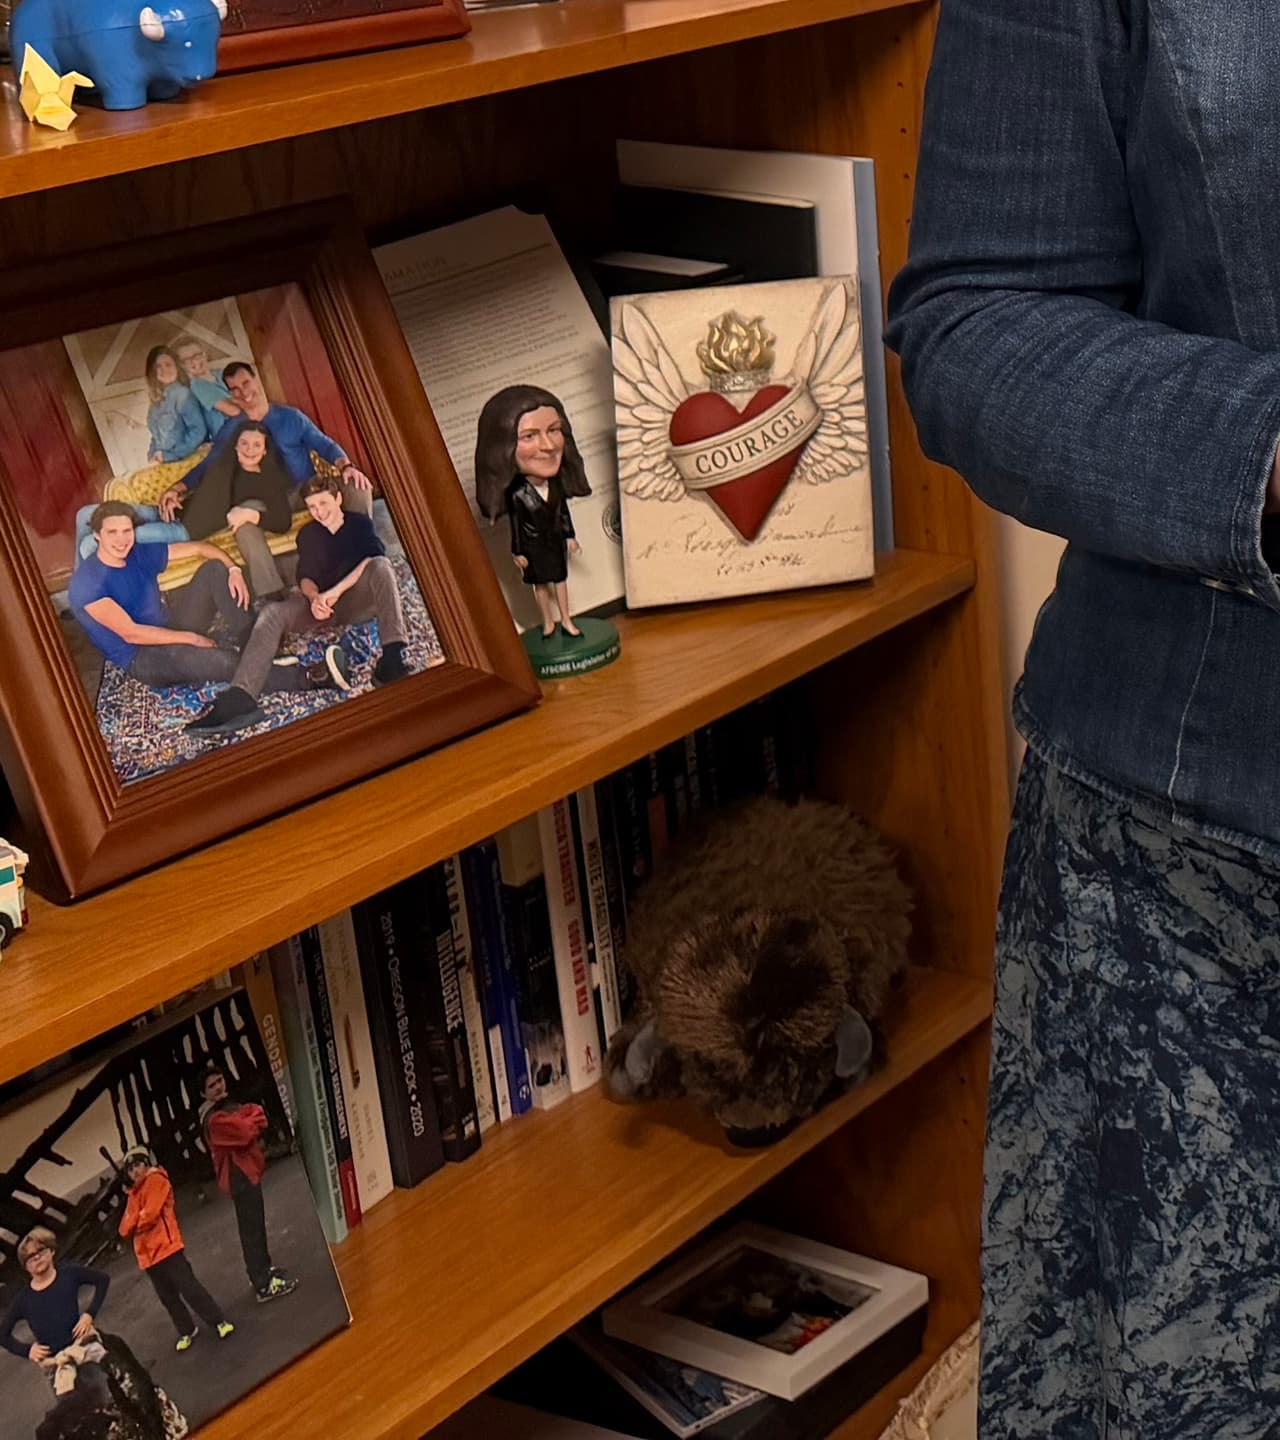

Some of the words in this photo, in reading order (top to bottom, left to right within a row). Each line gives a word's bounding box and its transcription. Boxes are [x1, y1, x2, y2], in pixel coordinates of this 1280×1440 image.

[696, 416, 805, 474] COURAGE
[381, 912, 395, 945] 2019
[388, 957, 406, 1016] OREGON
[436, 929, 463, 1034] INTELLIGENCE
[262, 1013, 284, 1079] GENDER
[397, 1017, 411, 1053] BLUE
[402, 1051, 418, 1096] BOOK
[410, 1101, 424, 1137] 2020
